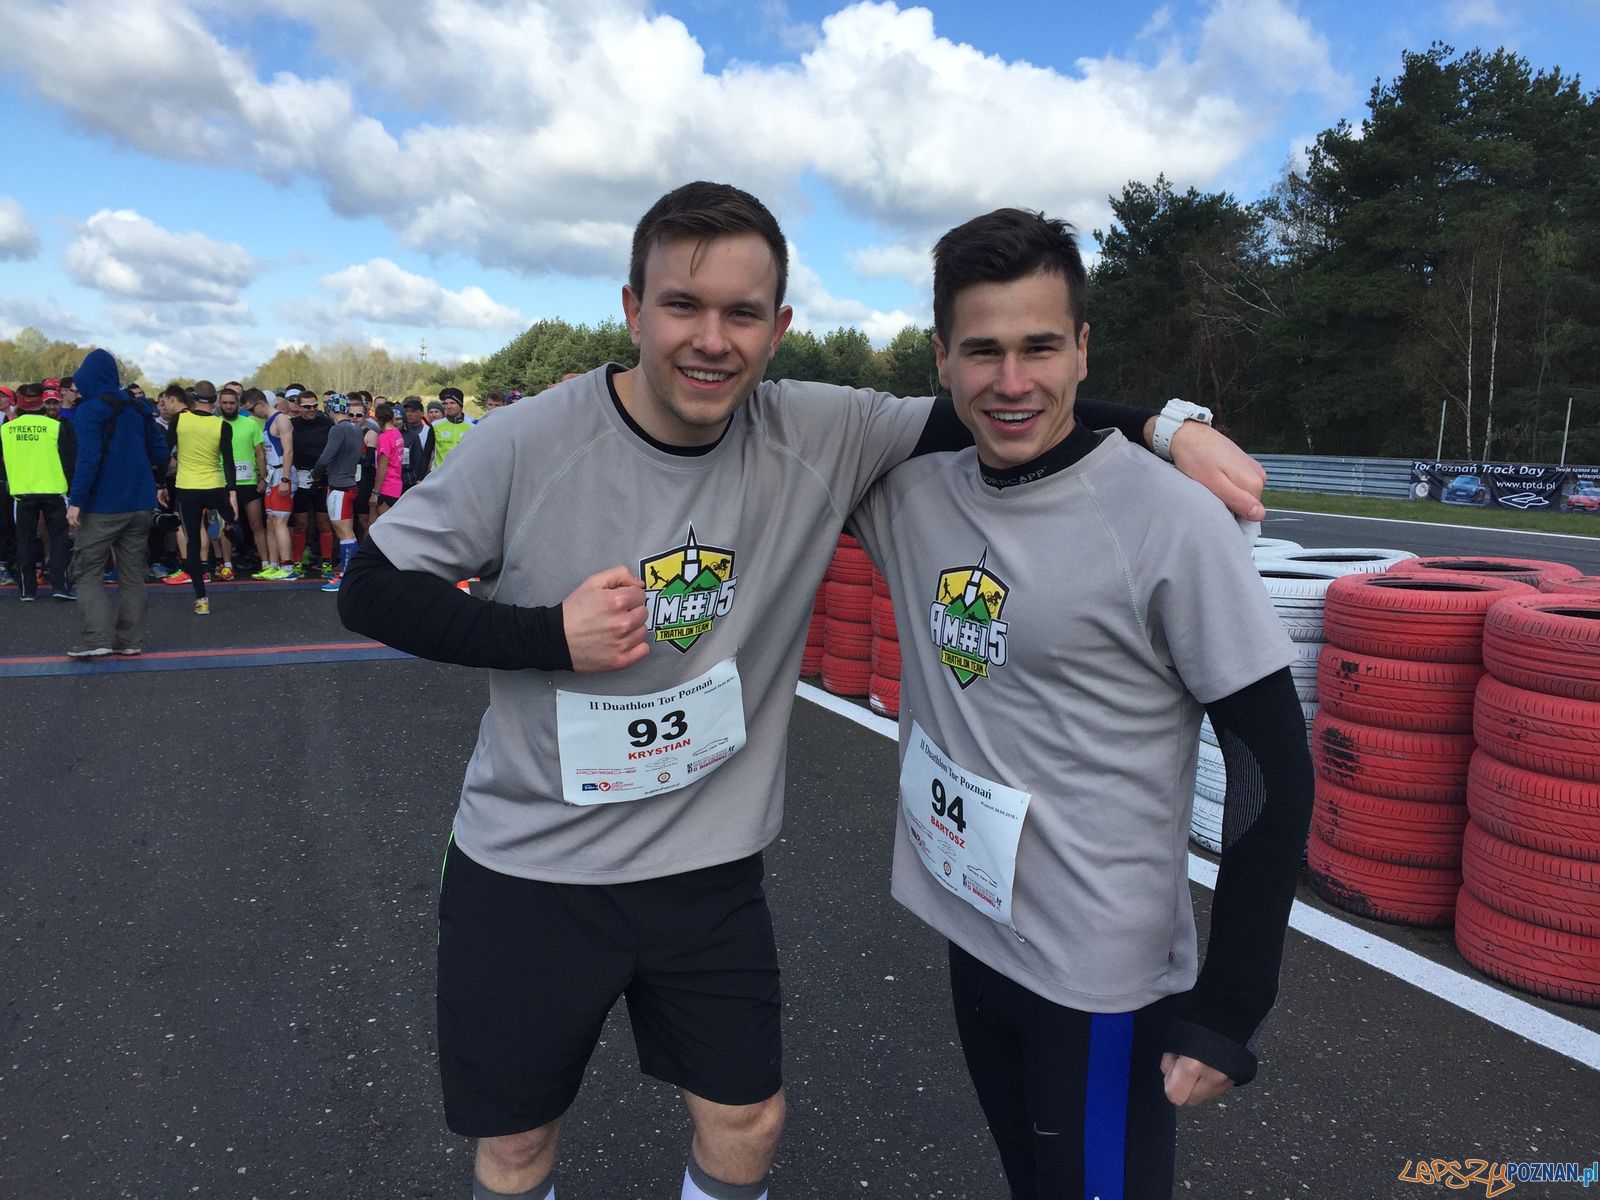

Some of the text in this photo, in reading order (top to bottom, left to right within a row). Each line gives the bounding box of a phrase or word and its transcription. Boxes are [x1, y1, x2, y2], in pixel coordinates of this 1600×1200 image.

[9, 425, 47, 434] DYREKTOR
[1414, 461, 1545, 477] Tor Poznań Track Day
[1496, 480, 1556, 490] www.tptd.pl
[660, 623, 709, 640] TRIATHLON TEAM
[929, 601, 1008, 667] AM#15
[971, 659, 984, 674] TEAM
[602, 701, 655, 711] Duathlon
[657, 695, 676, 705] Tor
[678, 676, 713, 699] Poznań
[627, 709, 689, 748] 93
[628, 738, 691, 760] KRYSTIAN
[960, 776, 992, 800] Poznań
[931, 778, 967, 834] 94
[930, 815, 965, 850] BARTOSZ
